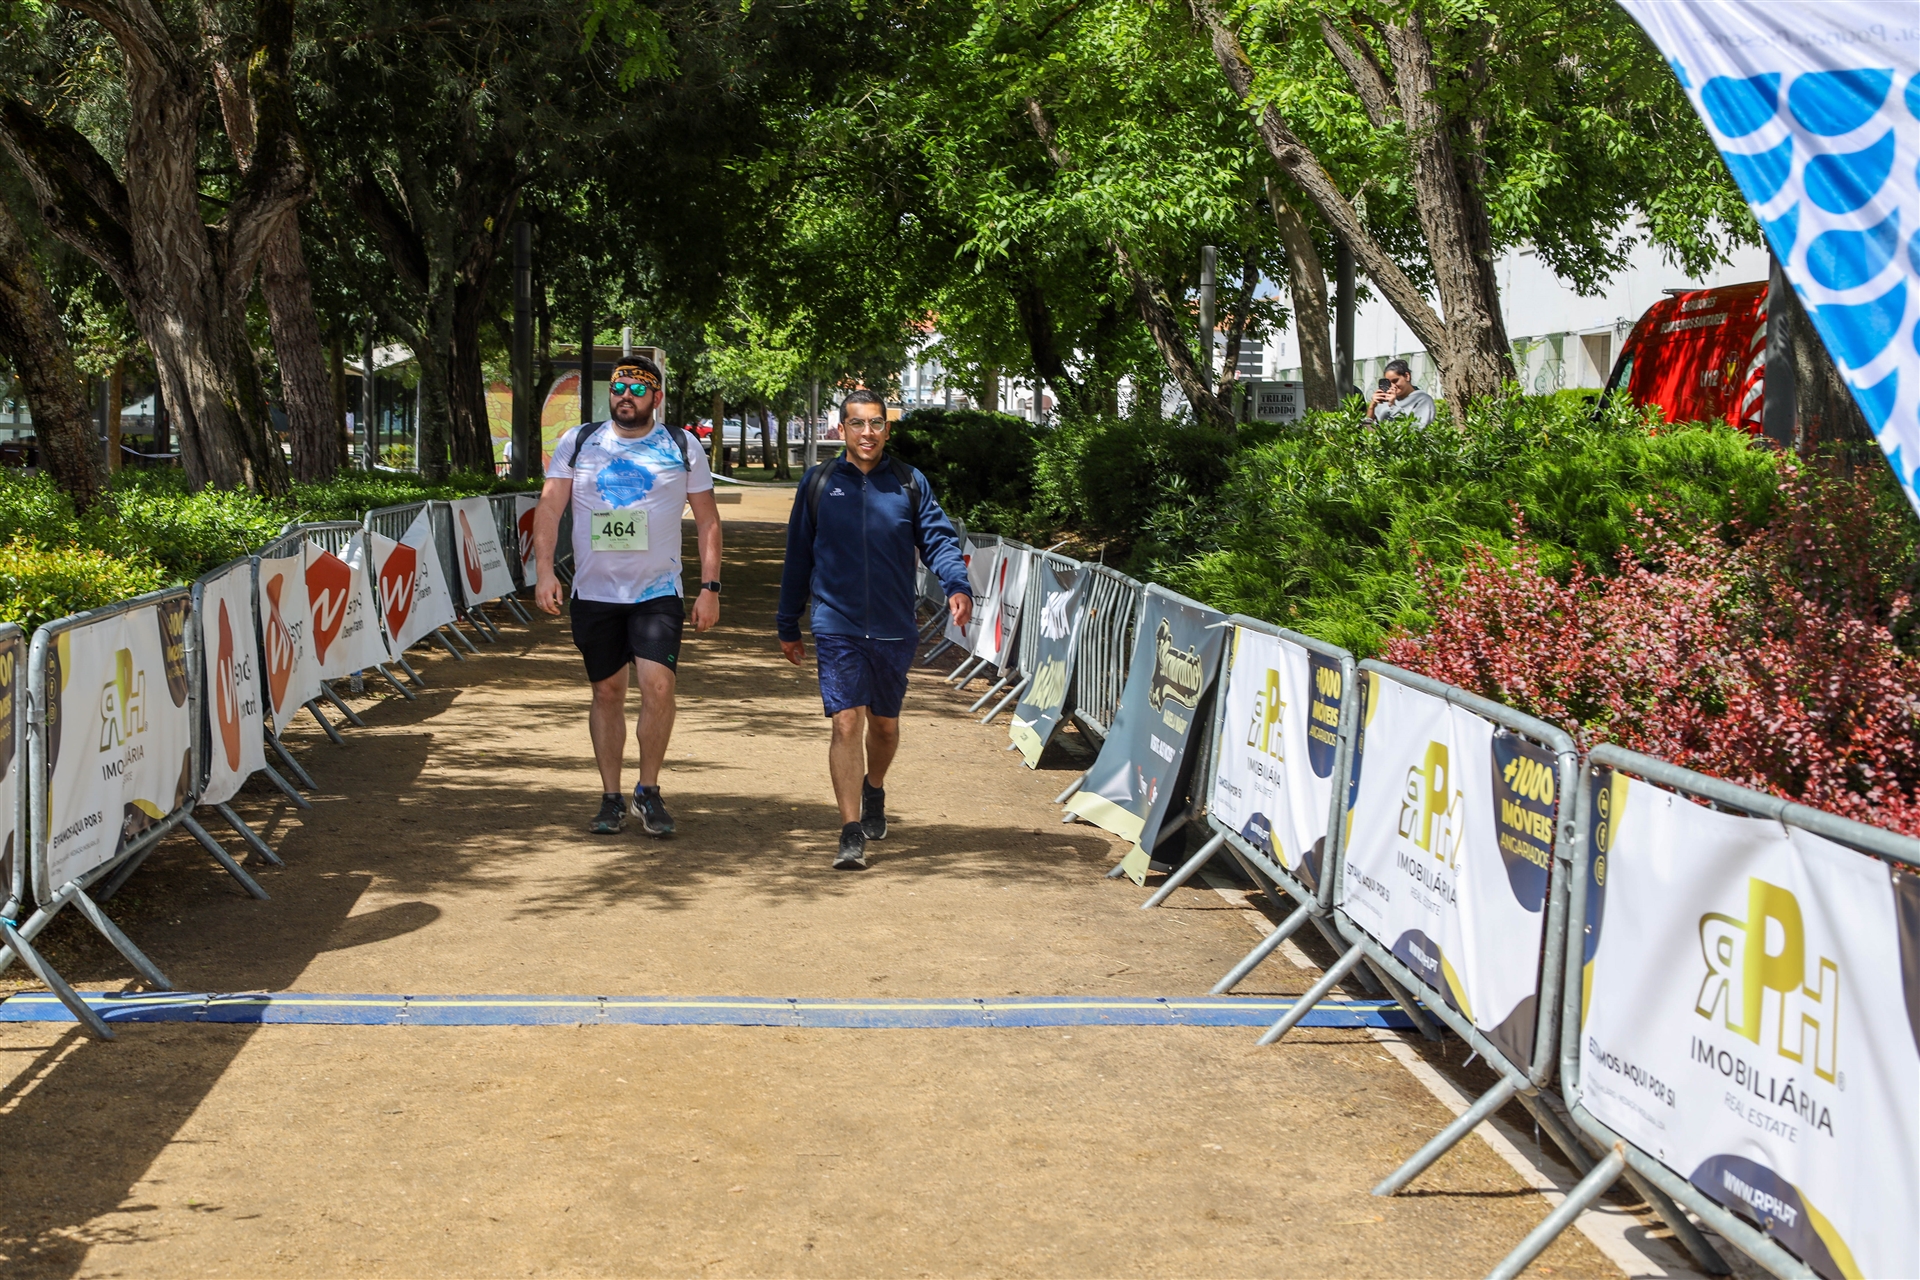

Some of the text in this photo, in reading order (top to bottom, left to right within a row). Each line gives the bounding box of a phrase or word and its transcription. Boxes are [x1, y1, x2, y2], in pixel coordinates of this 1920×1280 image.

[1258, 405, 1296, 415] PERDIDO
[1261, 394, 1294, 404] TRILHO
[602, 521, 636, 538] 464
[1312, 698, 1340, 728] IMÓVEIS
[1503, 755, 1555, 806] +1000
[1502, 797, 1553, 845] IMÓVEIS
[1500, 831, 1549, 872] ANGARIADOS
[1396, 850, 1458, 910] IMOBILIÁRIA
[1623, 1062, 1649, 1088] AQUI
[1649, 1075, 1666, 1101] POR
[1666, 1088, 1676, 1109] SI
[1690, 1035, 1835, 1138] IMOBILIÁRIA
[1724, 1091, 1800, 1144] REAL ESTATE
[1722, 1169, 1799, 1228] WWW.RPH.PT
